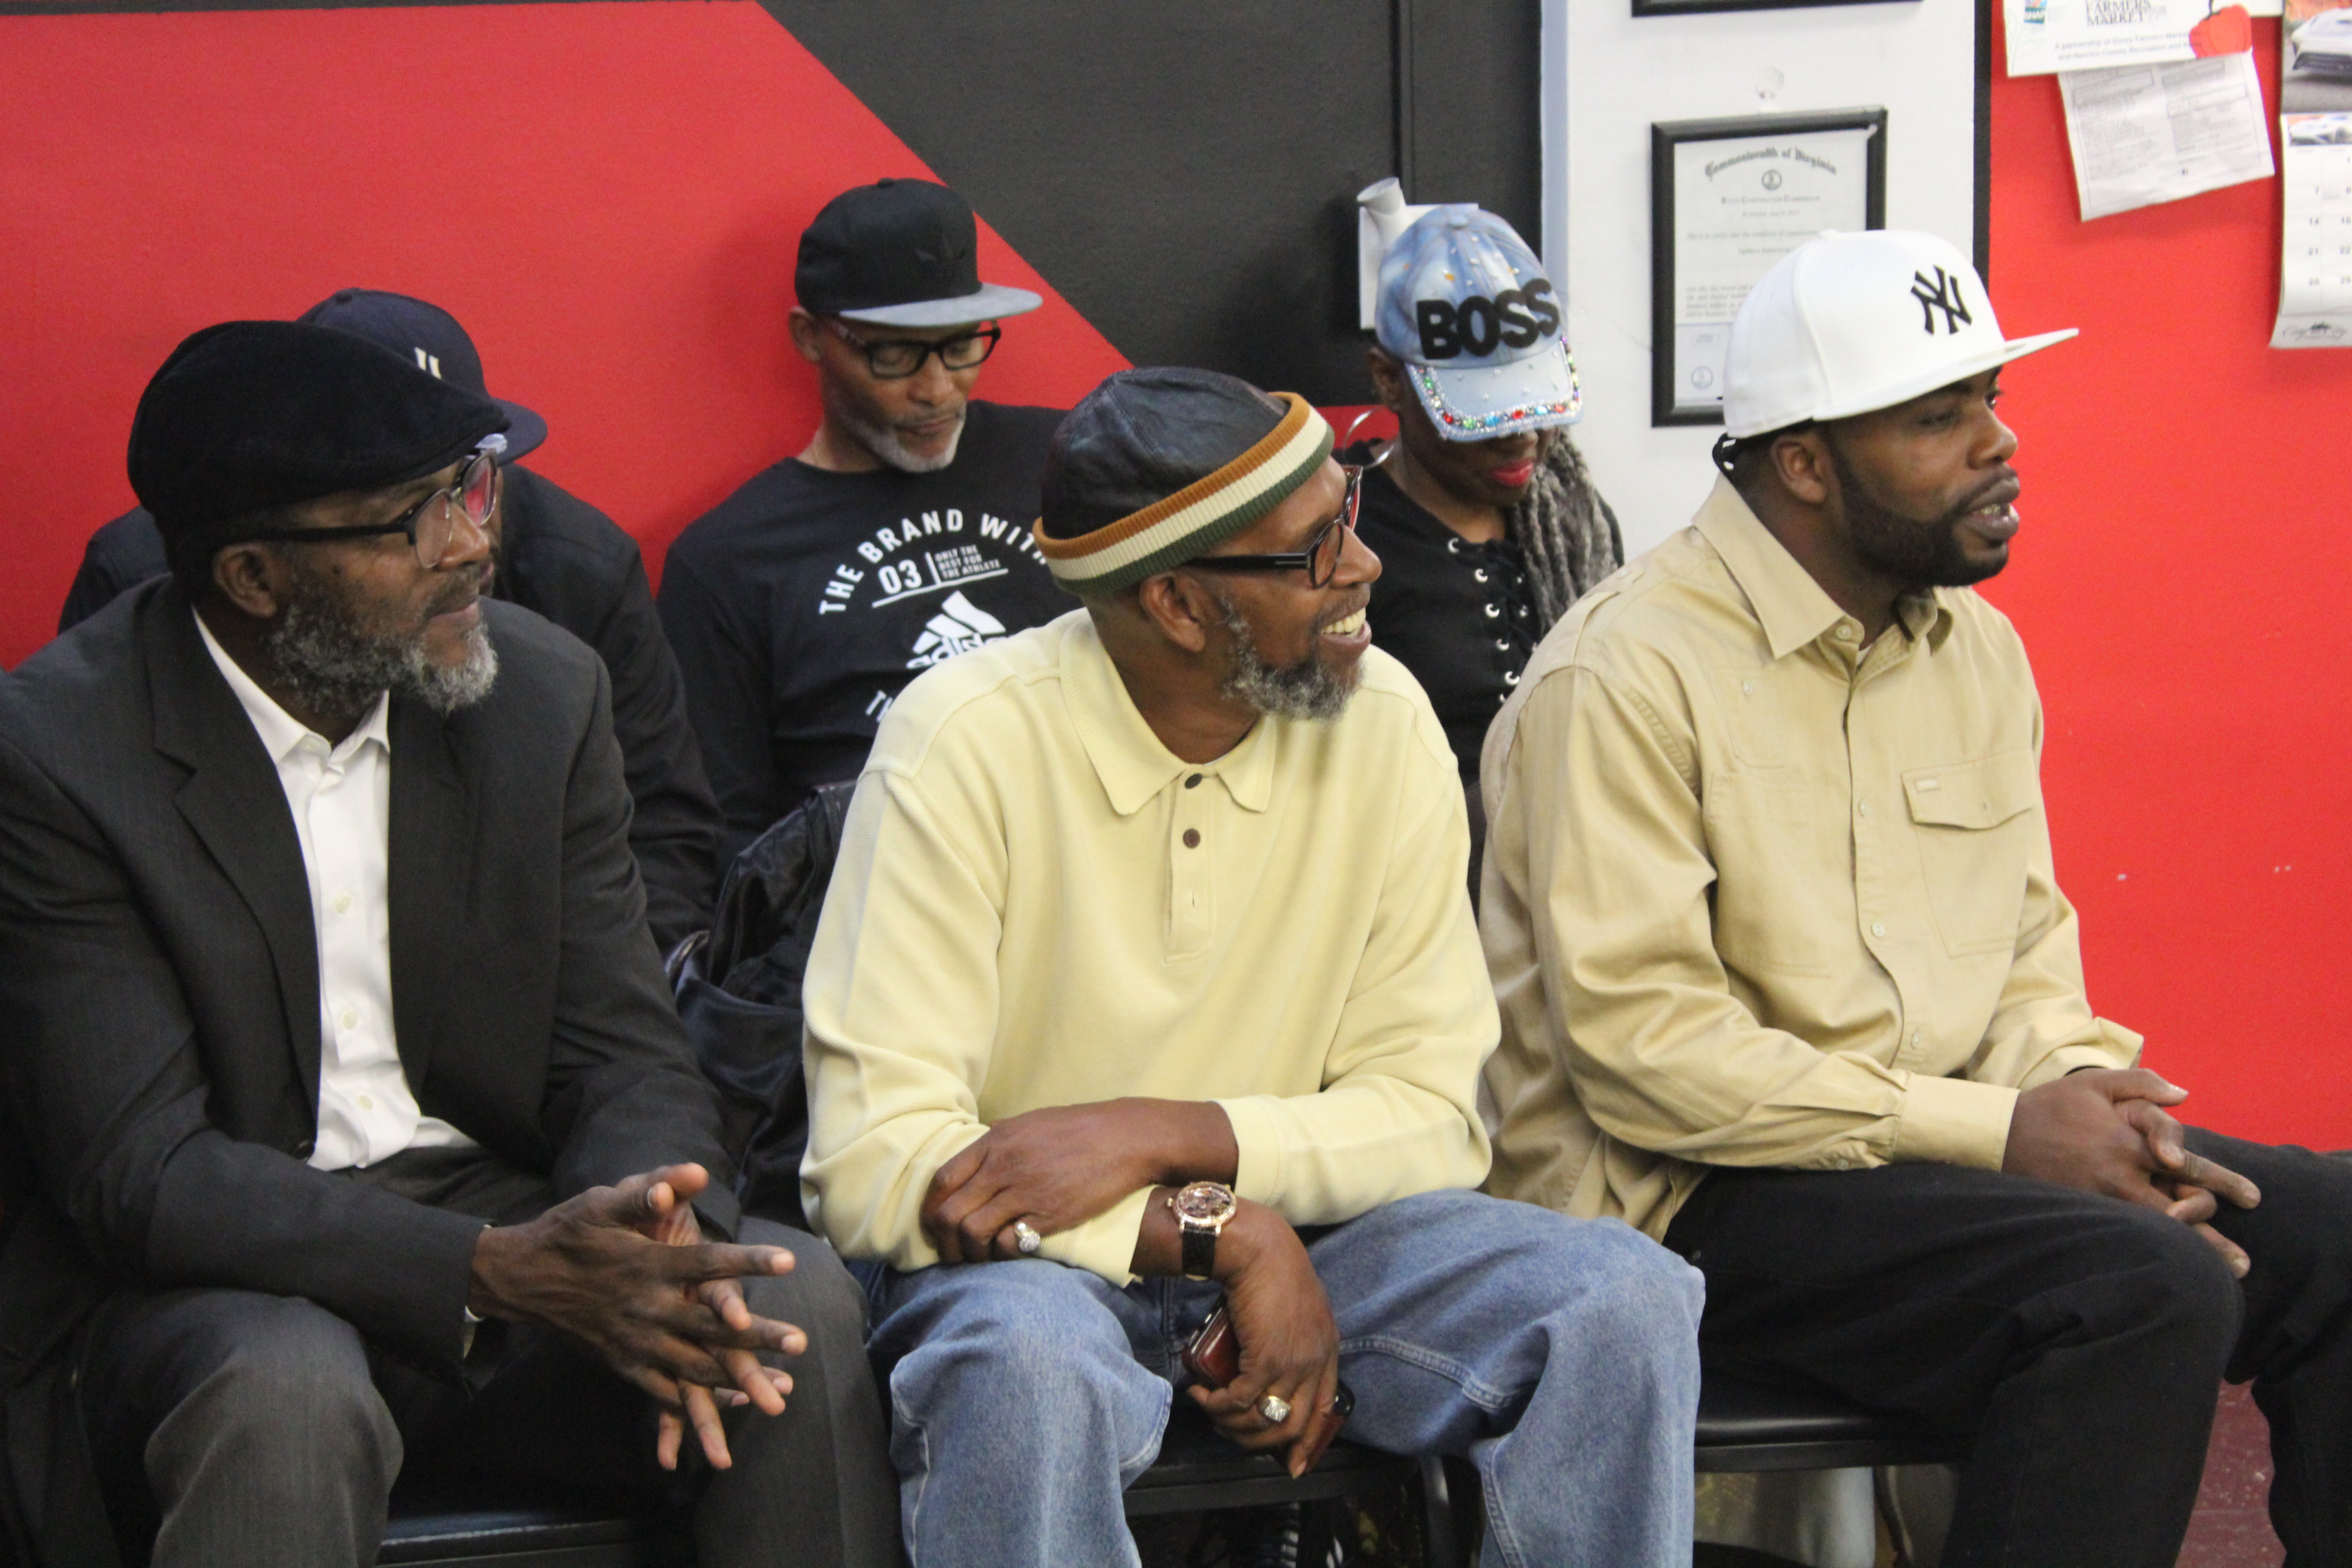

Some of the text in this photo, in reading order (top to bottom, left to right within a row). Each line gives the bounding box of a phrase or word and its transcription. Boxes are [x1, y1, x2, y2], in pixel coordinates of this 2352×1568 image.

[2087, 8, 2147, 26] MARKET
[2062, 38, 2102, 50] partnership
[1781, 147, 1793, 158] of
[1911, 264, 1972, 335] NY
[1417, 278, 1560, 359] BOSS
[819, 509, 1046, 615] THE BRAND WIT
[935, 544, 979, 562] ONLY THE
[938, 553, 983, 571] BEST FOR
[878, 559, 922, 595] 03
[941, 559, 1001, 579] THE ATHLETE
[906, 632, 1008, 669] adid
